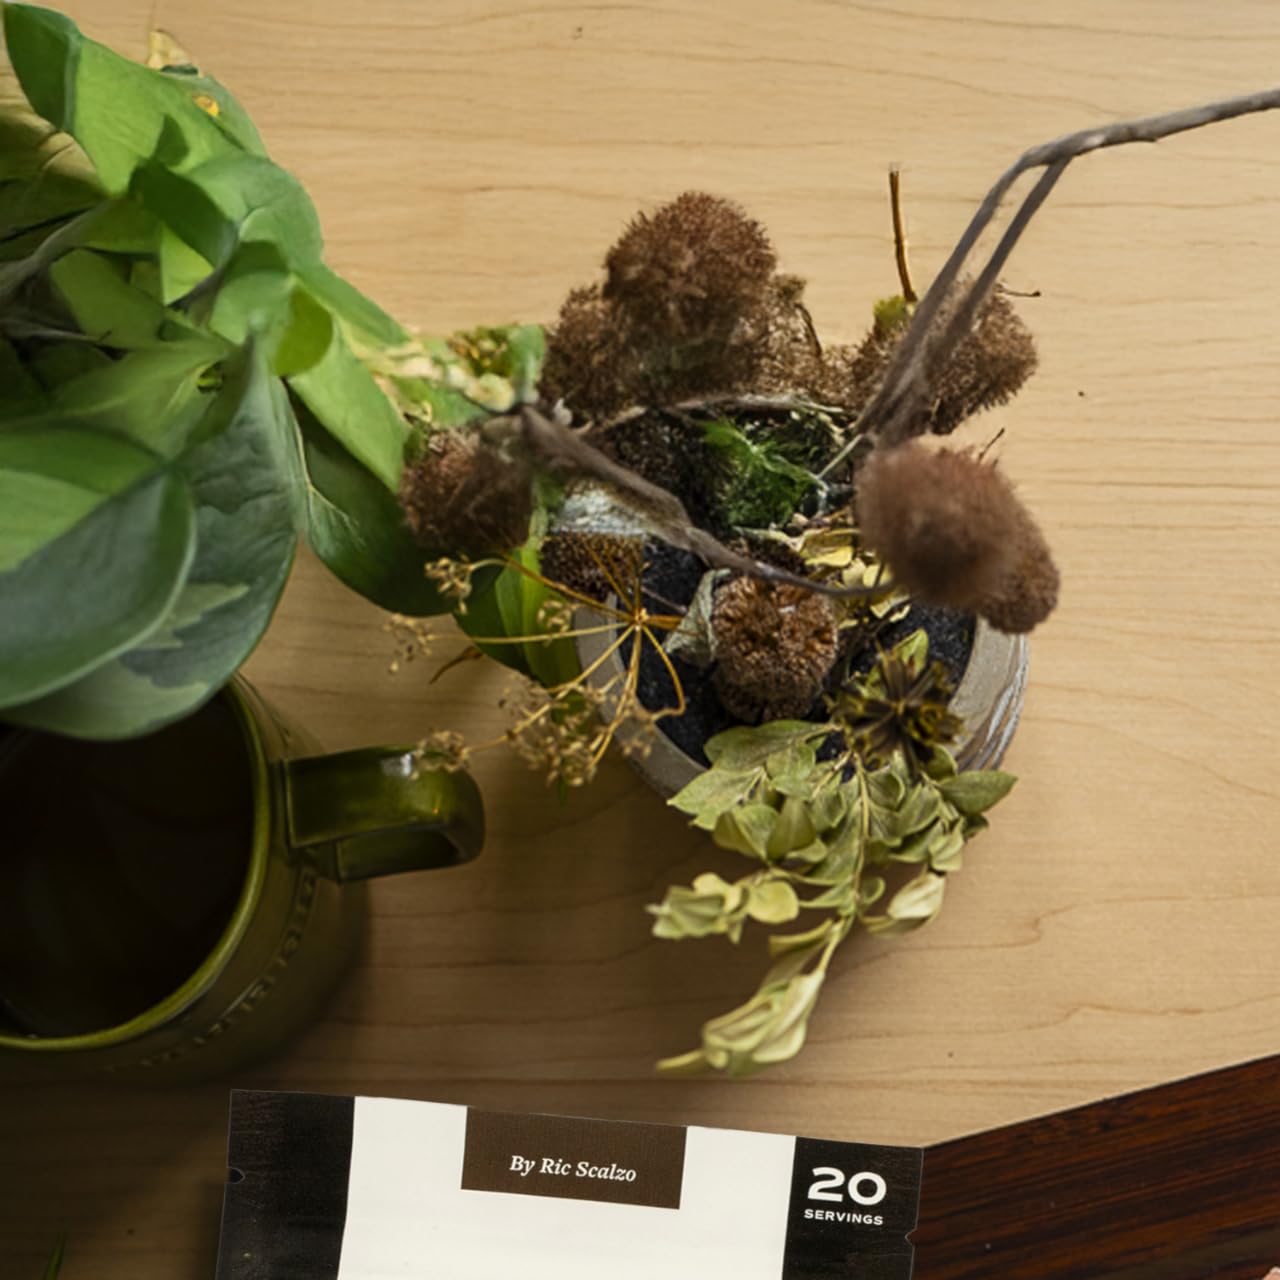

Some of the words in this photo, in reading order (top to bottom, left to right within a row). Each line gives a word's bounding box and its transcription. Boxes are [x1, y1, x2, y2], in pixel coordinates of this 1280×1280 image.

[509, 1155, 535, 1176] By
[539, 1157, 572, 1176] Ric
[575, 1161, 637, 1182] Scalzo
[807, 1166, 888, 1206] 20
[803, 1208, 884, 1226] SERVINGS
